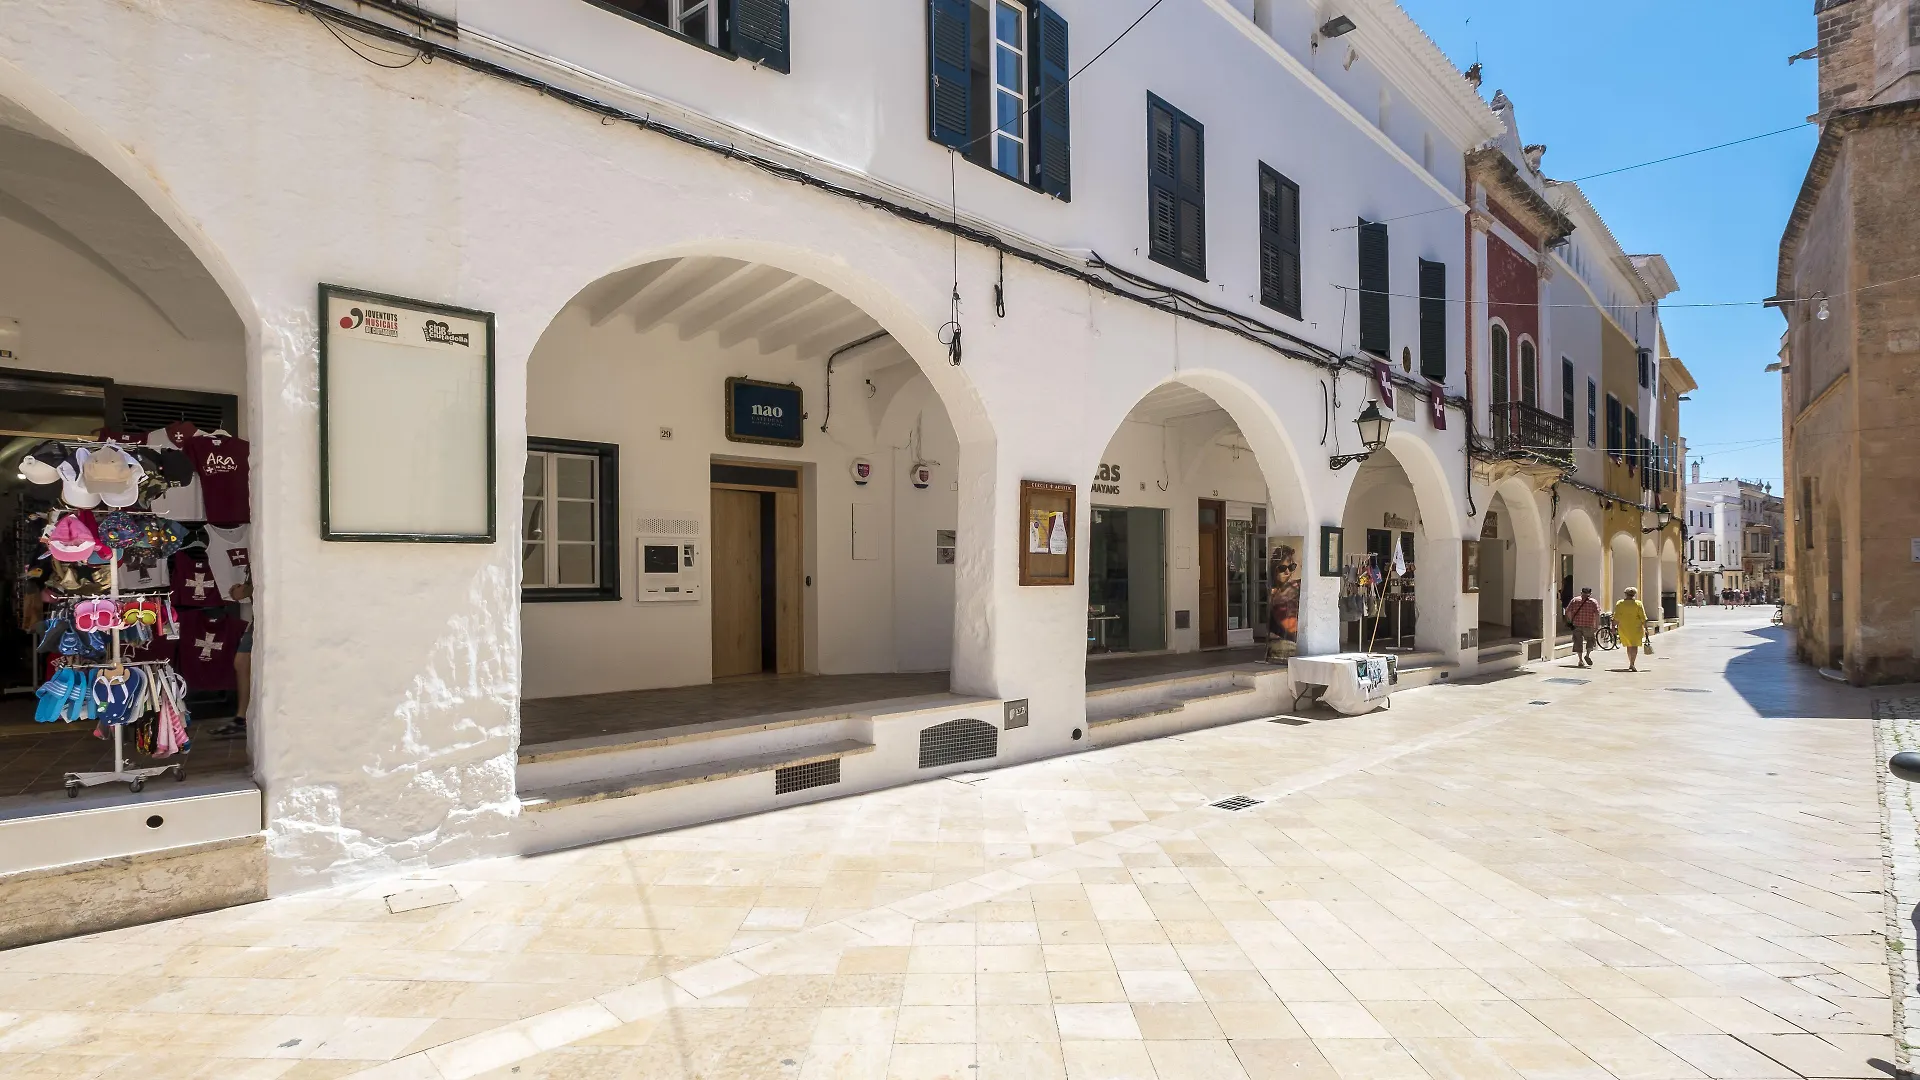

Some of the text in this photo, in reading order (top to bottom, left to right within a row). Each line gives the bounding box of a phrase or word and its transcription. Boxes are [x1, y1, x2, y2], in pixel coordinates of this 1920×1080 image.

[365, 310, 398, 322] JOVENTUTS
[365, 317, 398, 330] MUSICALS
[751, 404, 783, 418] nao
[661, 430, 671, 438] 29
[1090, 483, 1120, 495] MAYANS
